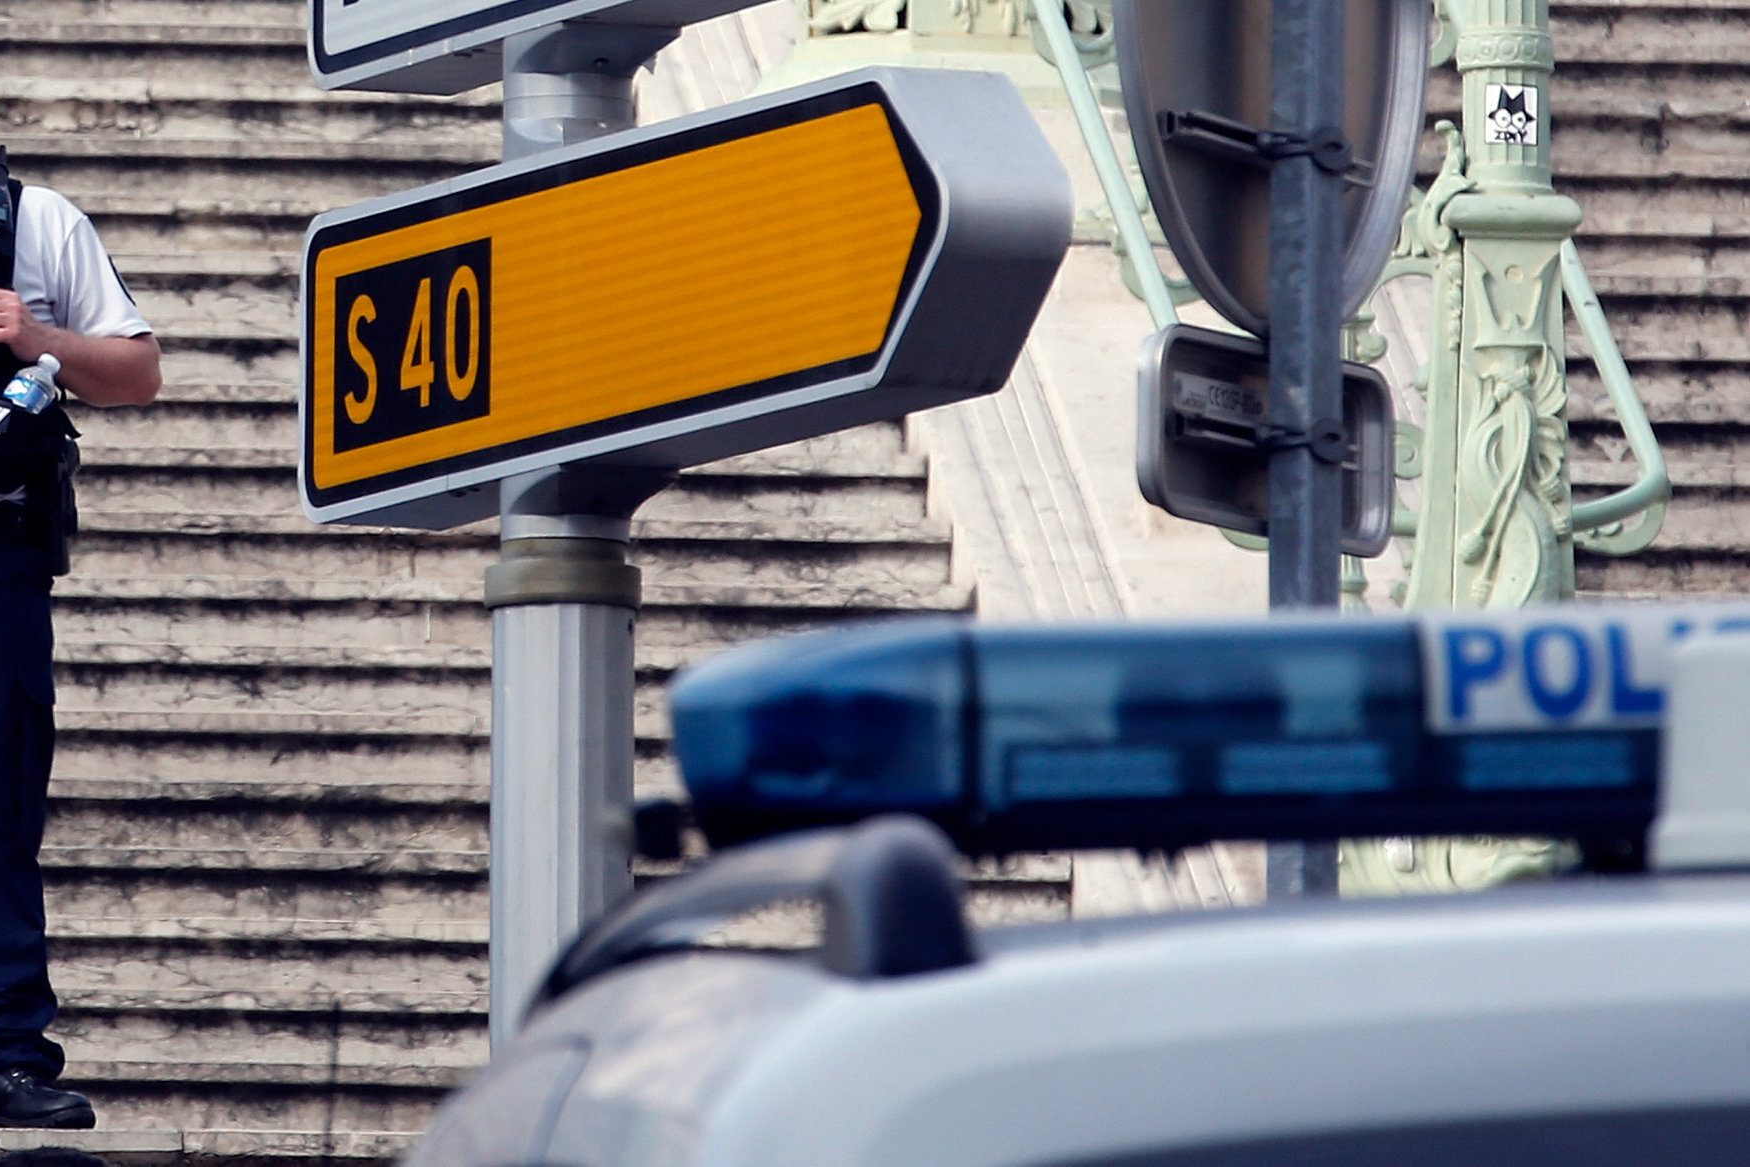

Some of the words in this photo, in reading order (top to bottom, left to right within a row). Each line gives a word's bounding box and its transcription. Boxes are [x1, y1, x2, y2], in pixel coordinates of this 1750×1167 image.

[344, 293, 378, 425] S
[399, 264, 481, 408] 40
[1444, 619, 1750, 719] POL
